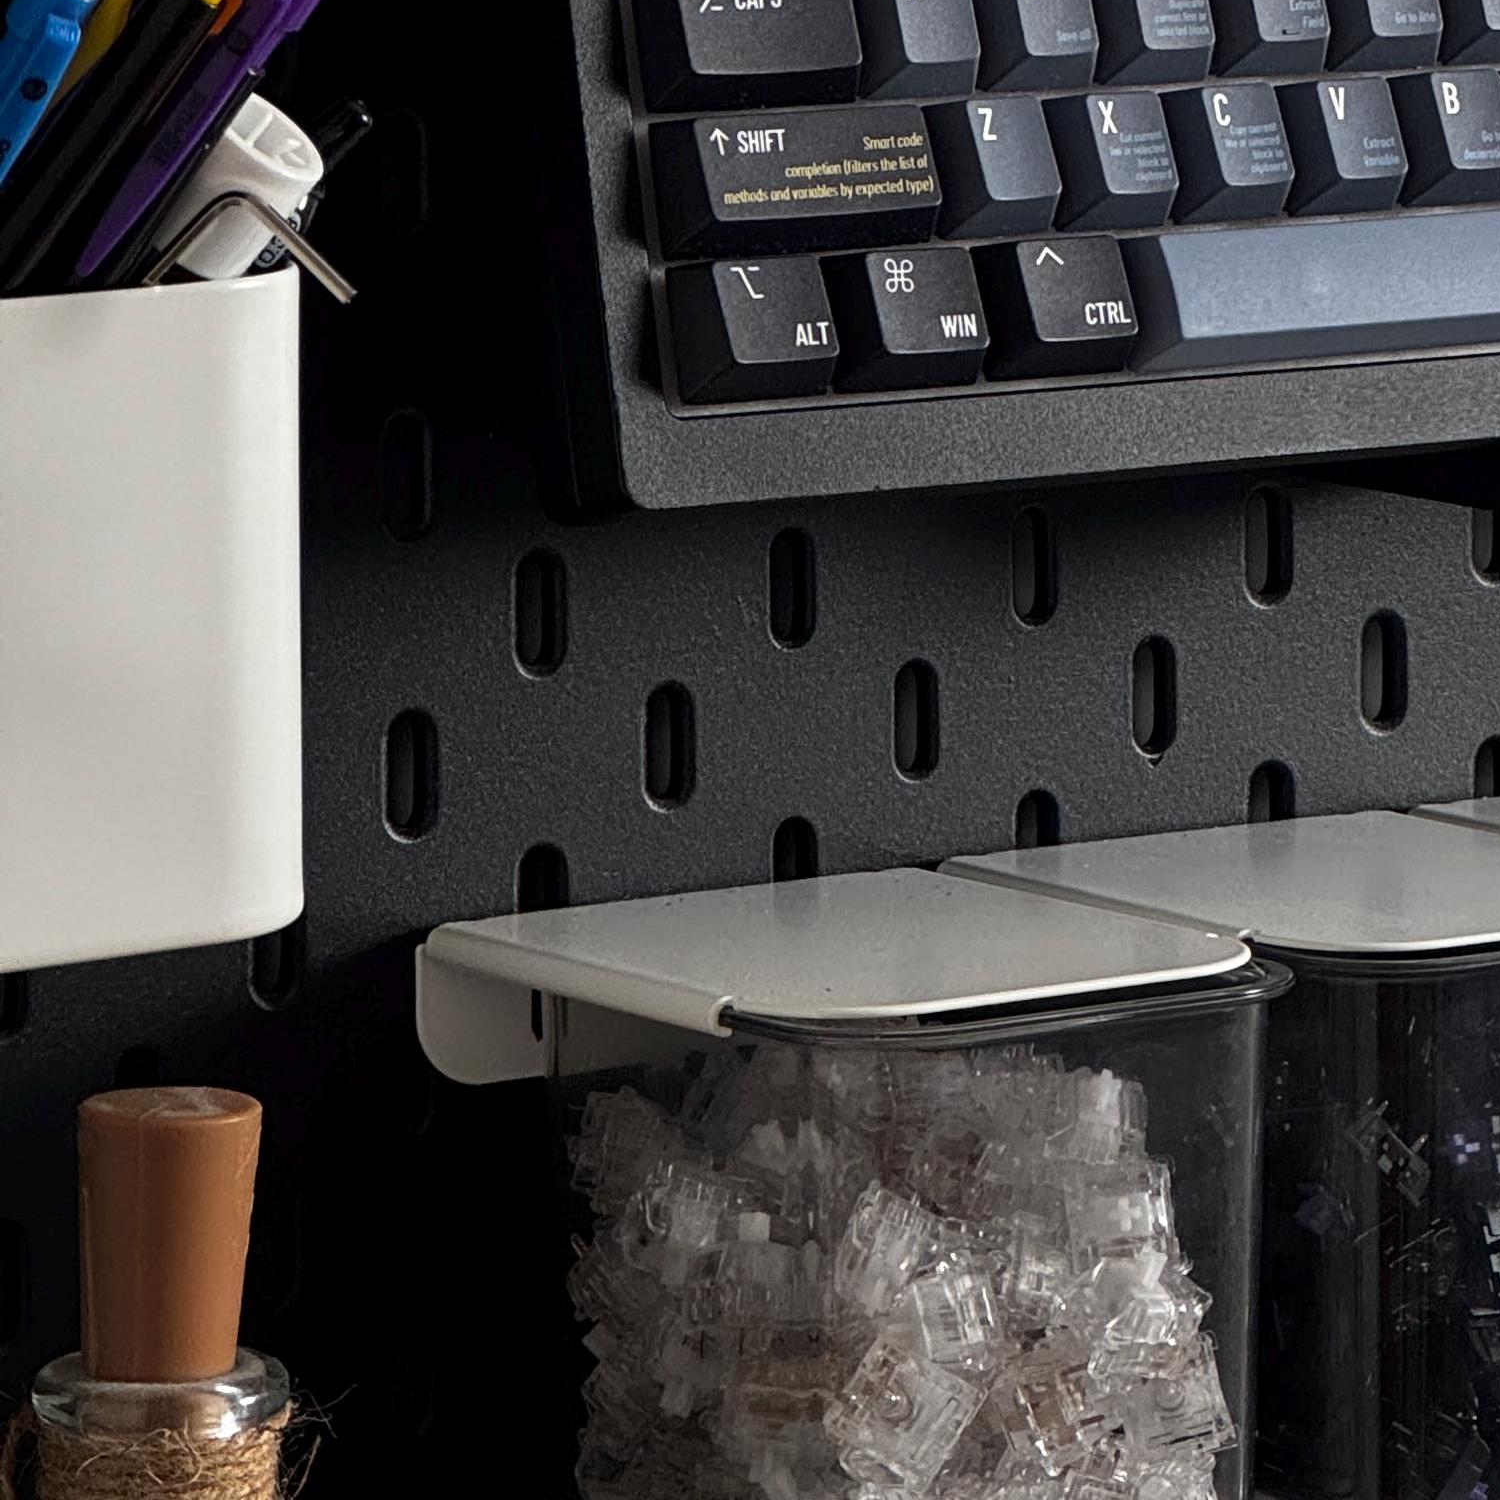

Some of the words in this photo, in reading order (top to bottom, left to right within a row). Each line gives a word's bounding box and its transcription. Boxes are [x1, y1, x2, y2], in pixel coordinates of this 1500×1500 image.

[1213, 93, 1230, 126] C
[1329, 87, 1344, 119] V
[1442, 82, 1459, 114] B
[978, 108, 997, 140] Z
[1098, 101, 1117, 133] X
[737, 129, 784, 153] SHIFT
[863, 135, 895, 151] Smart
[897, 132, 924, 148] code
[785, 161, 841, 180] completion
[880, 156, 897, 172] the
[899, 155, 915, 170] list
[916, 154, 928, 168] of
[724, 189, 768, 205] methods
[771, 186, 790, 201] and
[792, 184, 838, 200] variables
[840, 183, 852, 198] by
[855, 179, 903, 198] expected
[905, 176, 934, 194] type)
[941, 314, 977, 337] WIN
[1085, 301, 1131, 324] CTRL
[796, 322, 828, 346] ALT
